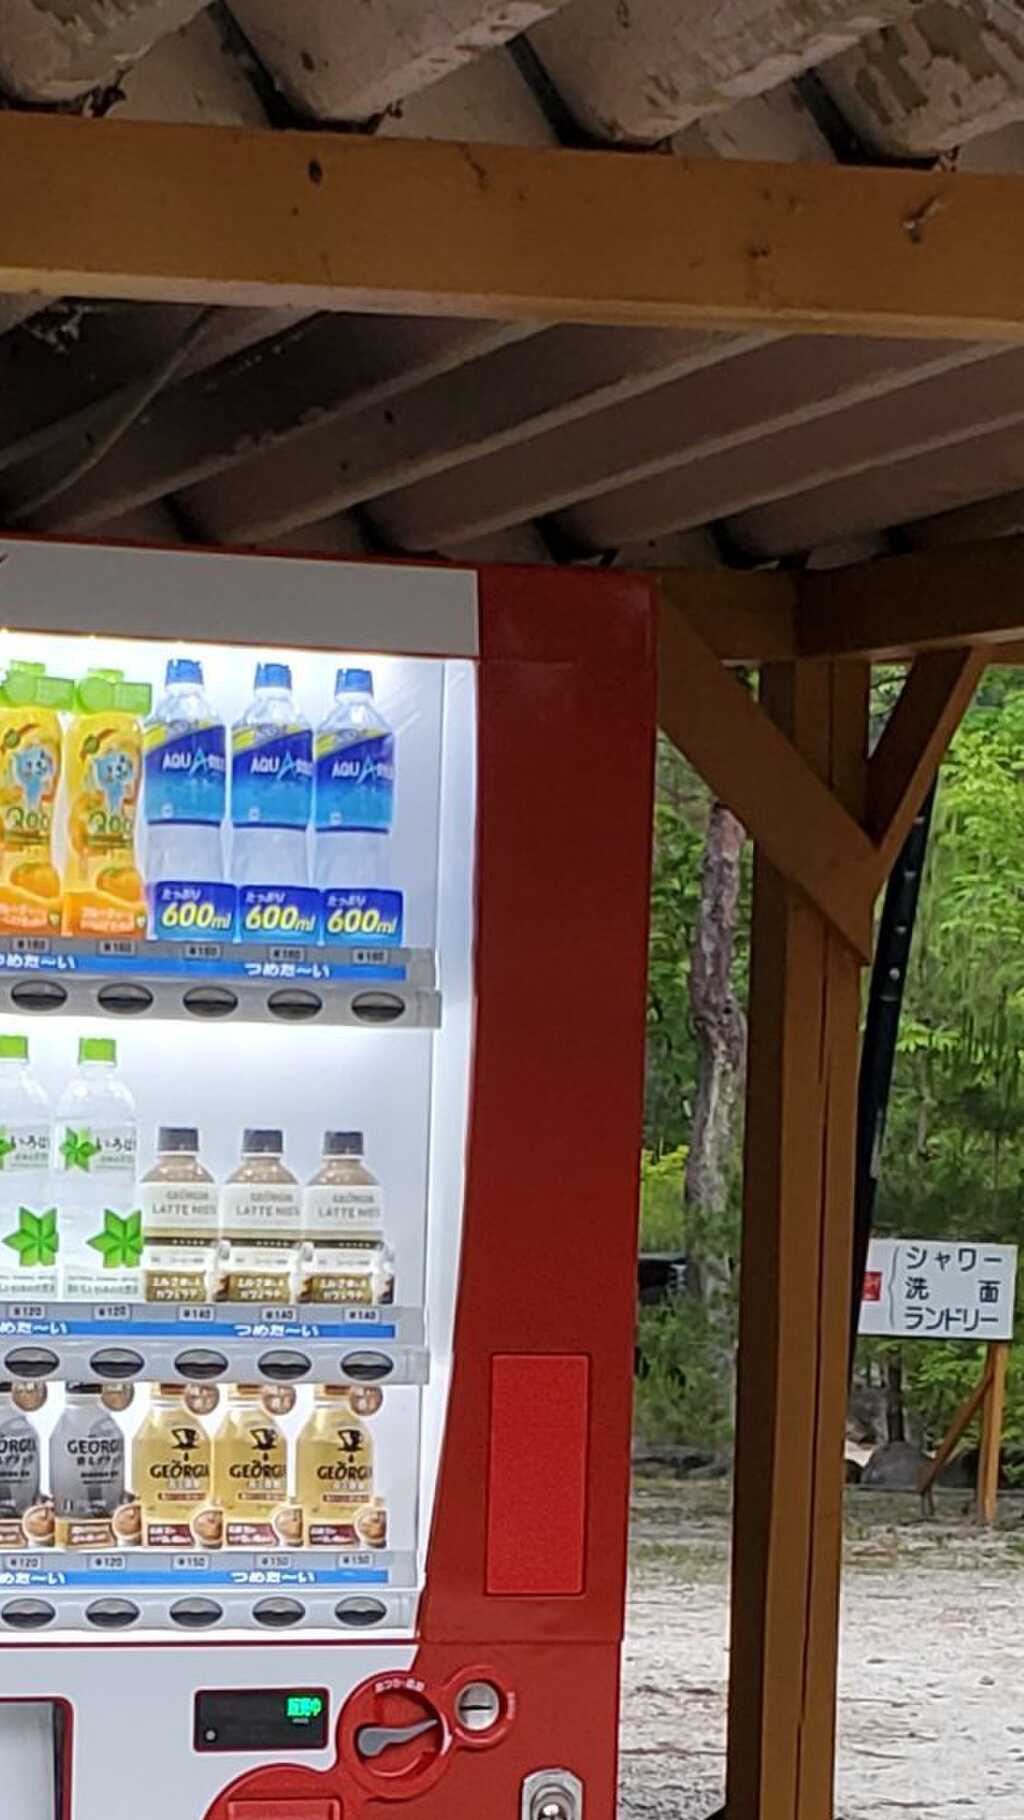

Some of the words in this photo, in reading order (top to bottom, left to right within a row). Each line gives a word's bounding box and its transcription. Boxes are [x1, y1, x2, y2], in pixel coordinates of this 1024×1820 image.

[905, 1246, 1002, 1271] シャワー
[904, 1276, 1001, 1303] 洗面
[904, 1306, 999, 1332] ランドリー
